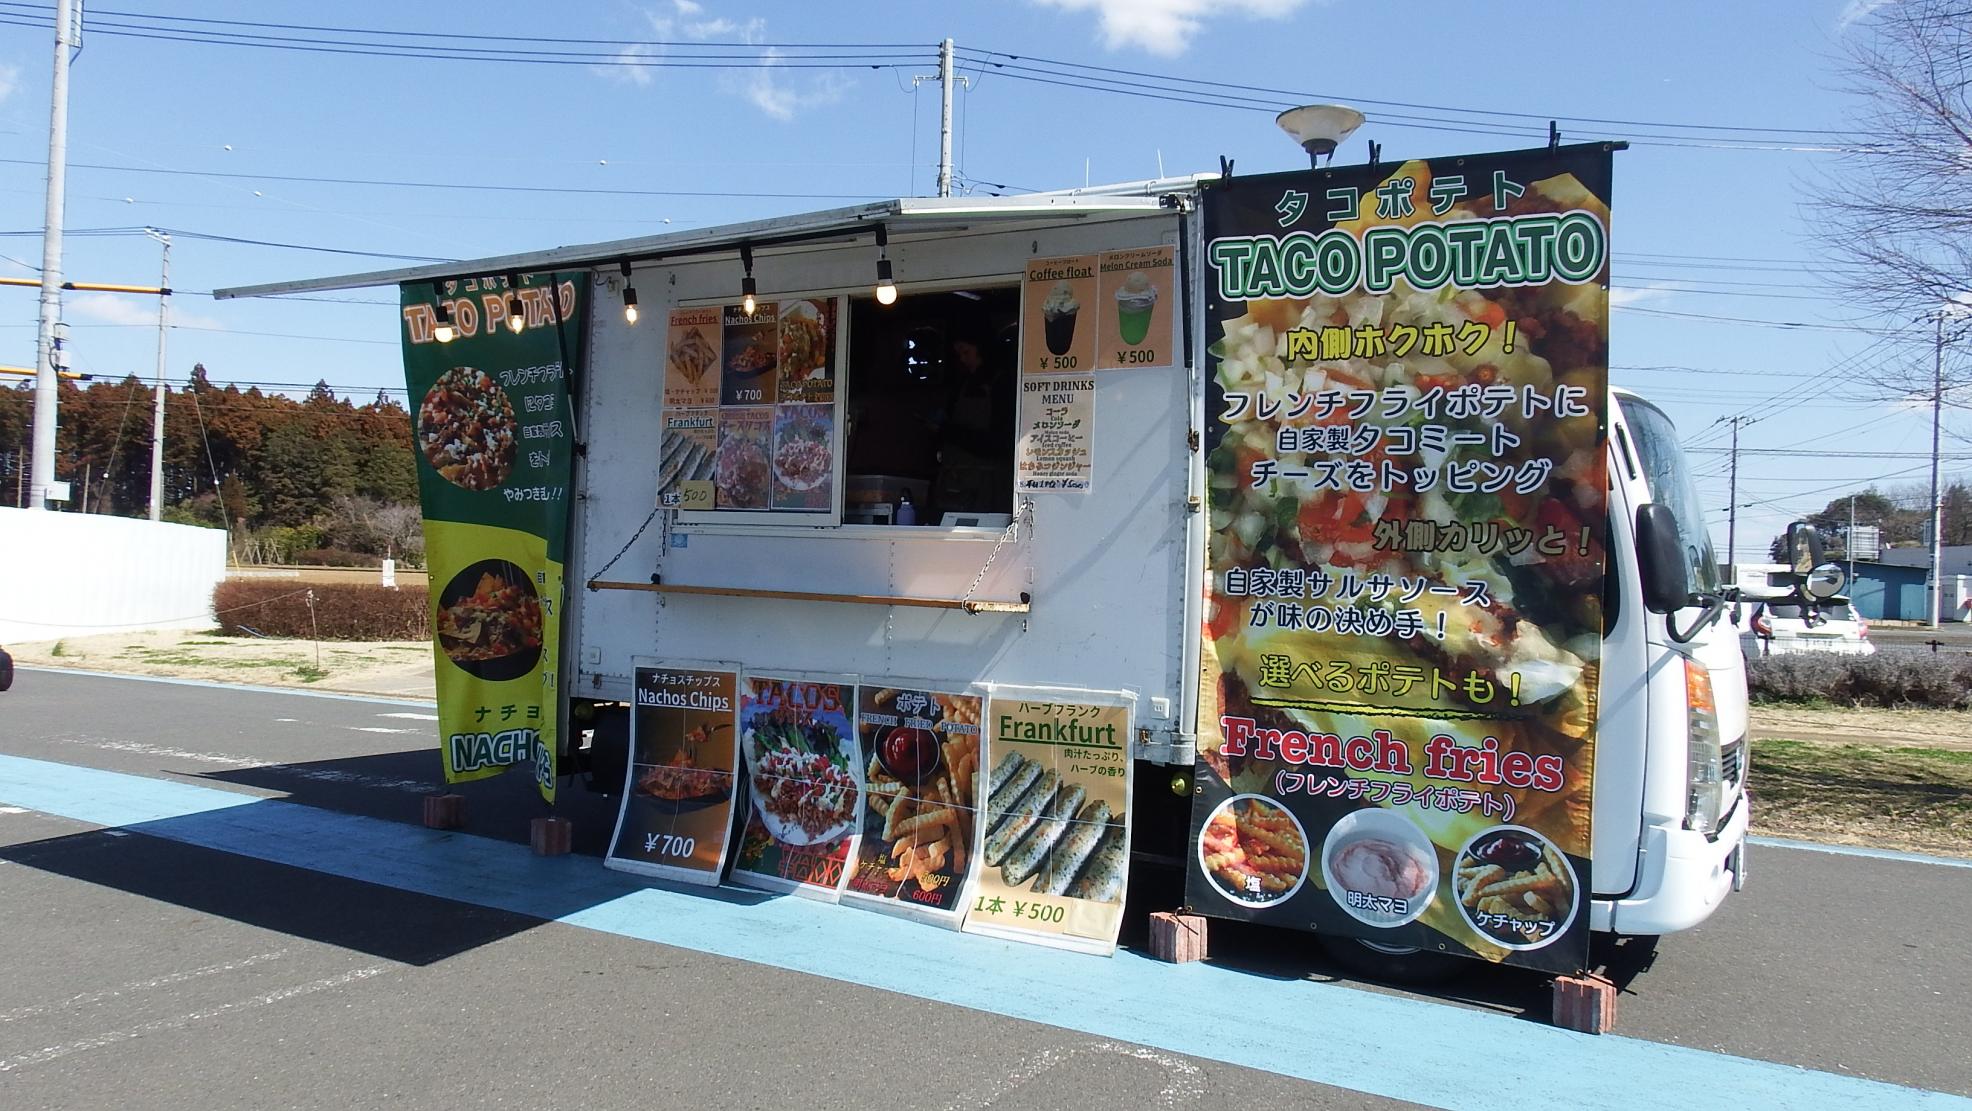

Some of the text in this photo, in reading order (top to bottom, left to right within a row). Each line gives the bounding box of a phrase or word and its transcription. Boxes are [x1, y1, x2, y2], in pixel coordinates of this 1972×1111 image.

[1274, 170, 1525, 227] タコポテト
[1100, 257, 1173, 272] Melon Cream Soda
[1207, 210, 1609, 302] TACO POTATO
[1030, 265, 1092, 280] Coffee float
[671, 313, 718, 325] French fries
[725, 313, 776, 325] Nachos Chips
[1287, 321, 1517, 362] 内側ホクホク！
[736, 389, 762, 401] ¥700
[1024, 380, 1095, 392] SOFT DRINKS
[1042, 394, 1074, 404] MENU
[1221, 385, 1591, 422] フレンチフライポテトに
[668, 416, 713, 427] Frankfurt
[1046, 407, 1068, 416] コーラ
[1033, 419, 1080, 429] メロンソーダ
[1030, 434, 1083, 443] アイスコーヒー
[1276, 424, 1521, 457] 自家製タコミート
[1251, 457, 1551, 495] チーズをトッピング
[1372, 519, 1592, 557] 外側カリッと！
[1224, 568, 1491, 609] 自家製サルサソース
[1249, 602, 1448, 641] が味の決め手！
[652, 673, 721, 687] ナチョスチップス
[1259, 655, 1524, 707] 選べるポテトも！
[638, 687, 729, 713] Nachos Chips
[751, 679, 841, 712] TACOS
[896, 693, 941, 716] ポテト
[1019, 702, 1101, 719] ハーブフランク
[861, 712, 978, 735] FRENCH FRIED POTATO
[1000, 714, 1116, 746] Frankfurt
[1219, 715, 1566, 792] French fries
[1070, 763, 1126, 777] ハーブの香り
[1275, 768, 1516, 823] (フレンチフライポテト)
[644, 833, 695, 857] ¥700
[1243, 874, 1262, 892] 塩
[912, 889, 943, 905] 600円
[974, 894, 1065, 924] 1本 ¥500
[1346, 890, 1410, 915] 明太マヨ
[1477, 910, 1556, 937] ケチャップ
